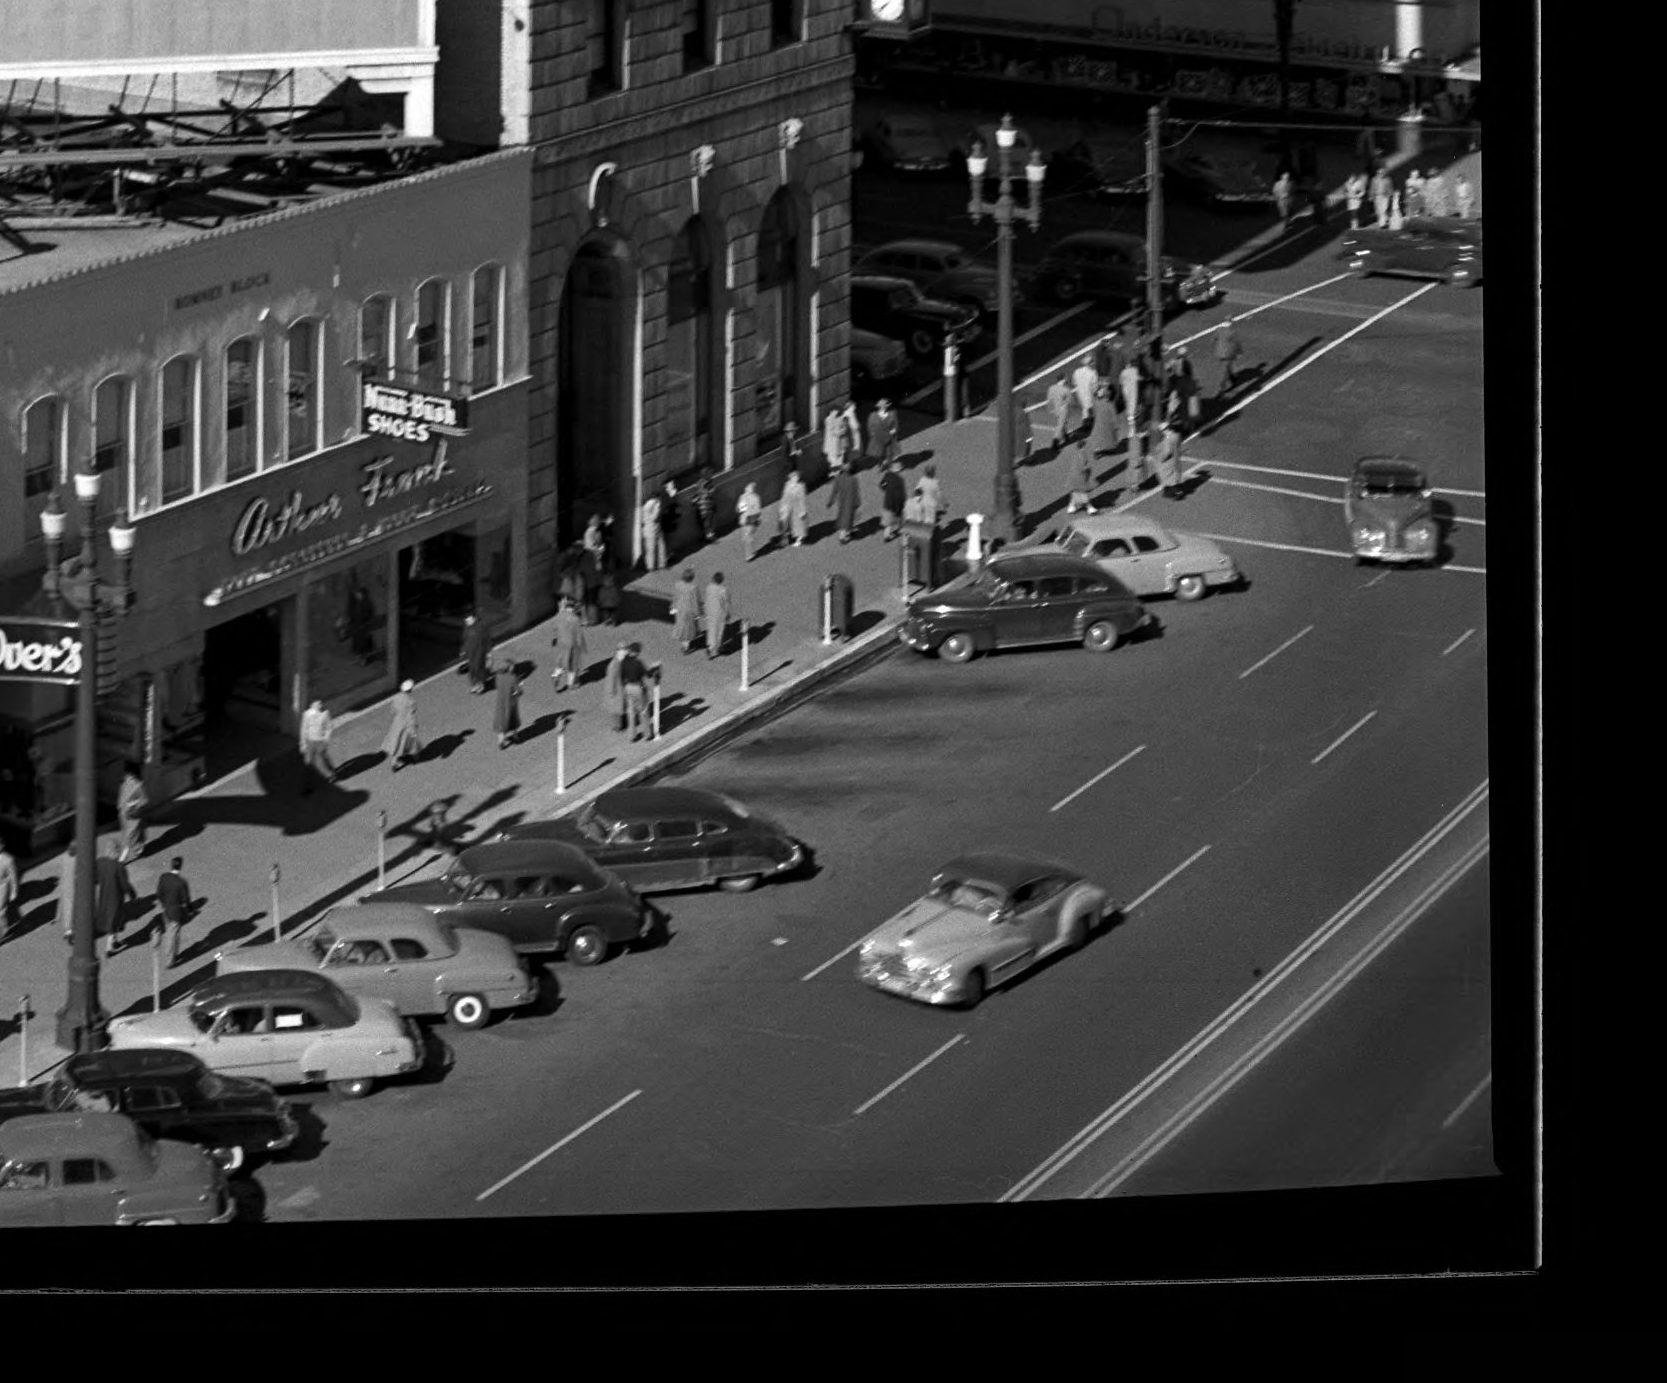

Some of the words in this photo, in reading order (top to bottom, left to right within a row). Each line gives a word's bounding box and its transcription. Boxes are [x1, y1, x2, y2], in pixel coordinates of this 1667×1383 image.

[366, 412, 431, 443] SHOES
[230, 490, 344, 558] Arthur
[360, 436, 456, 508] Frank
